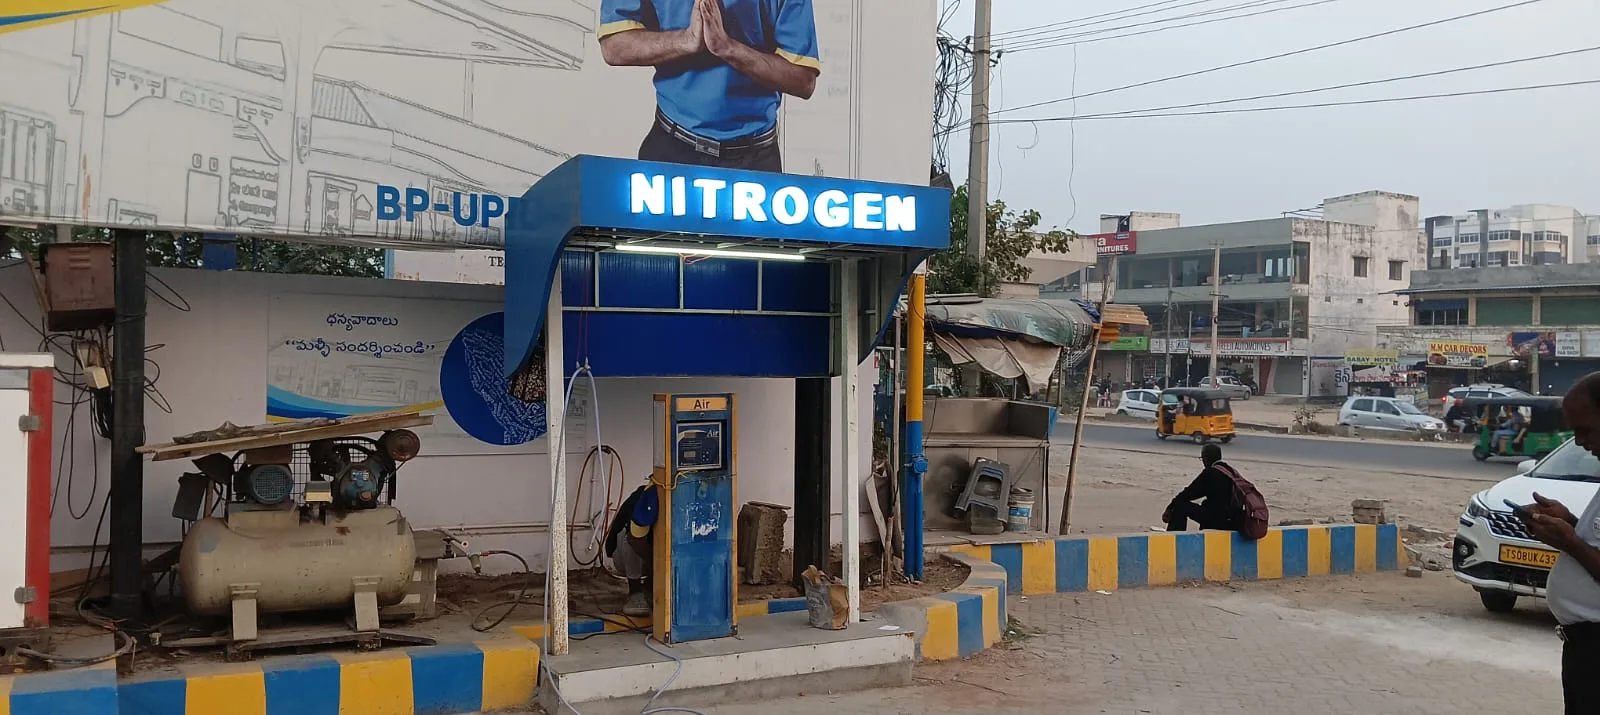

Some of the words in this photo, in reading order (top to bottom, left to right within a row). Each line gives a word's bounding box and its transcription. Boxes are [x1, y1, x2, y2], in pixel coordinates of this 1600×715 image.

[376, 184, 521, 228] BP-UP
[629, 171, 918, 232] NITROGEN
[326, 312, 399, 331] ధన్యవాదాలు
[1444, 344, 1458, 353] CAR
[1459, 344, 1487, 354] DECORS
[693, 399, 710, 409] Air
[706, 429, 719, 438] Air
